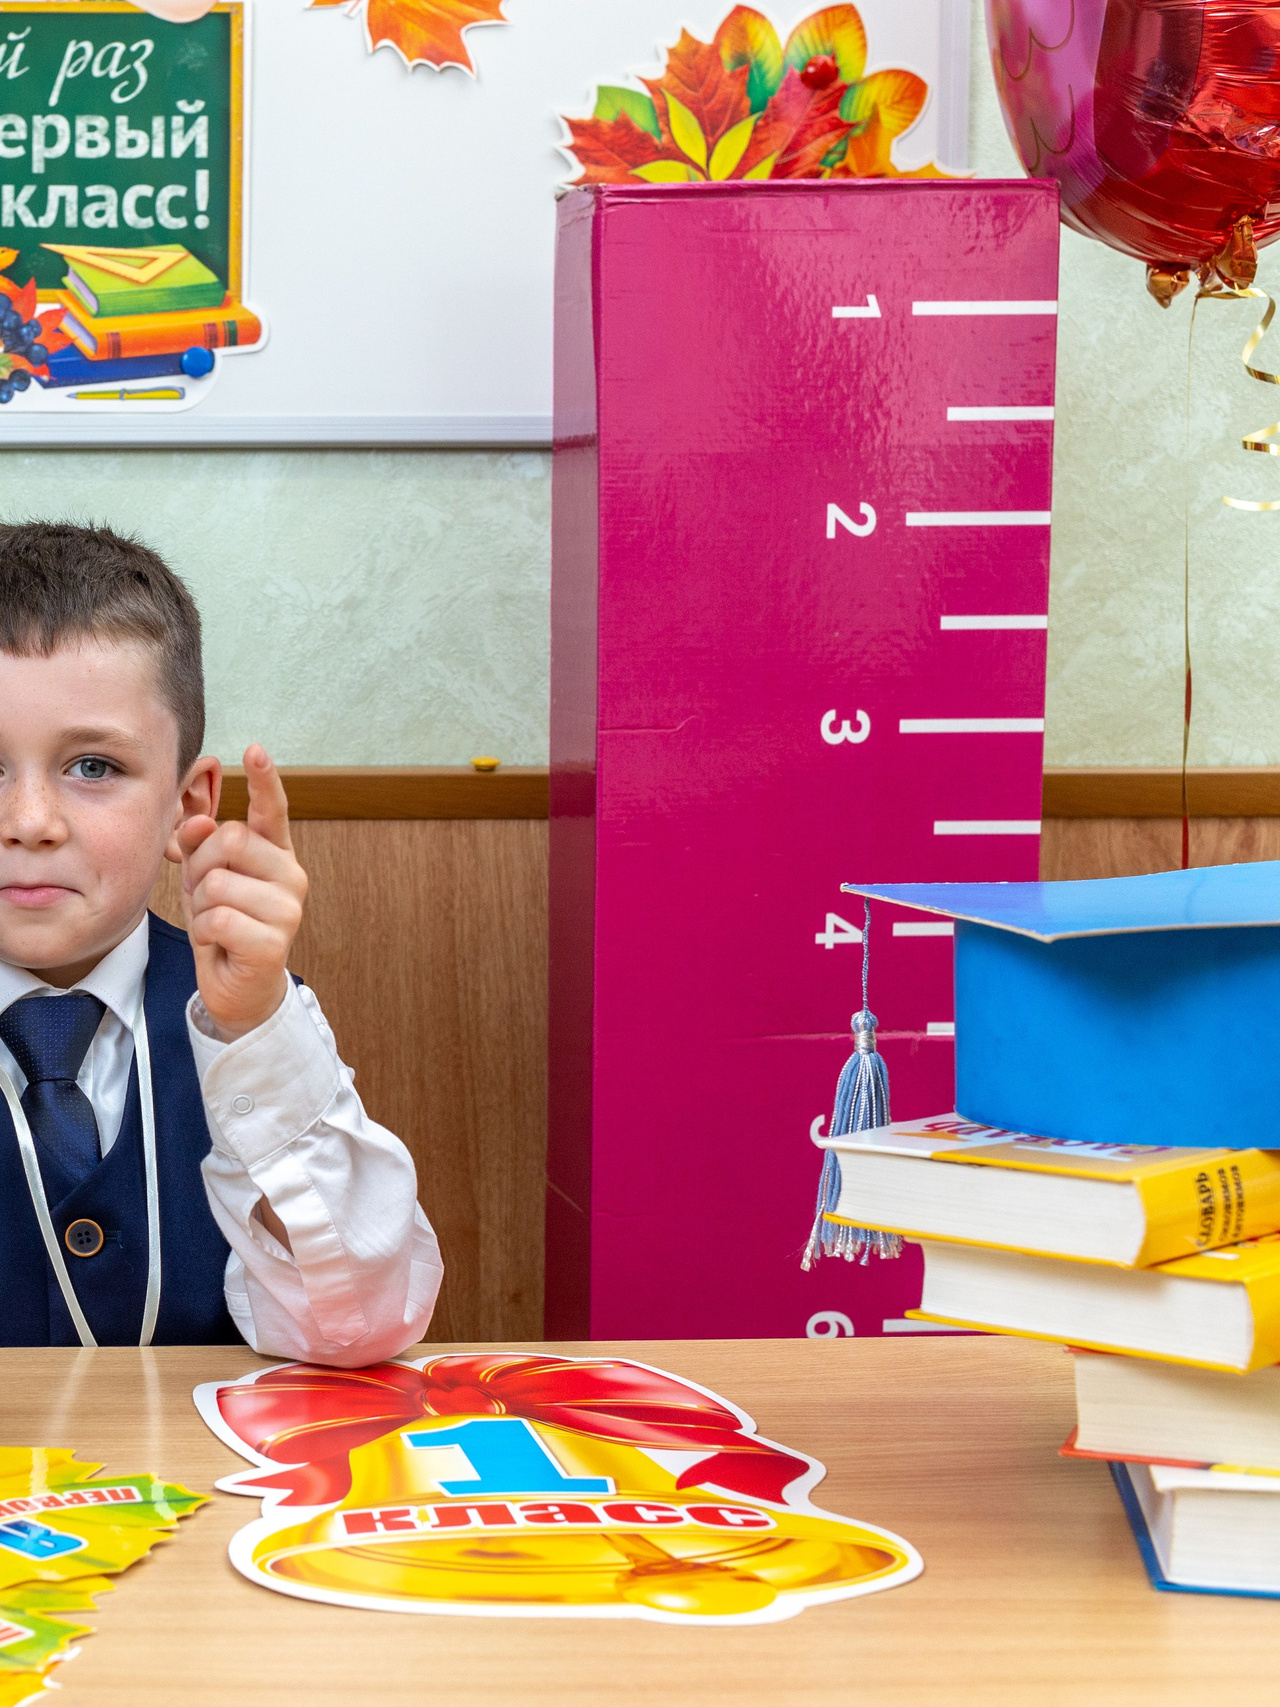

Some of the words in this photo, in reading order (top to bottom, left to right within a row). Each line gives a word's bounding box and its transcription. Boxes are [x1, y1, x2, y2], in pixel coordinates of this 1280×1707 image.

[48, 38, 154, 107] раз
[0, 169, 211, 230] класс!
[831, 293, 882, 318] 1
[826, 501, 877, 539] 2
[820, 709, 871, 745] 3
[815, 912, 866, 949] 4
[407, 1419, 616, 1495] 1
[341, 1500, 771, 1535] класс
